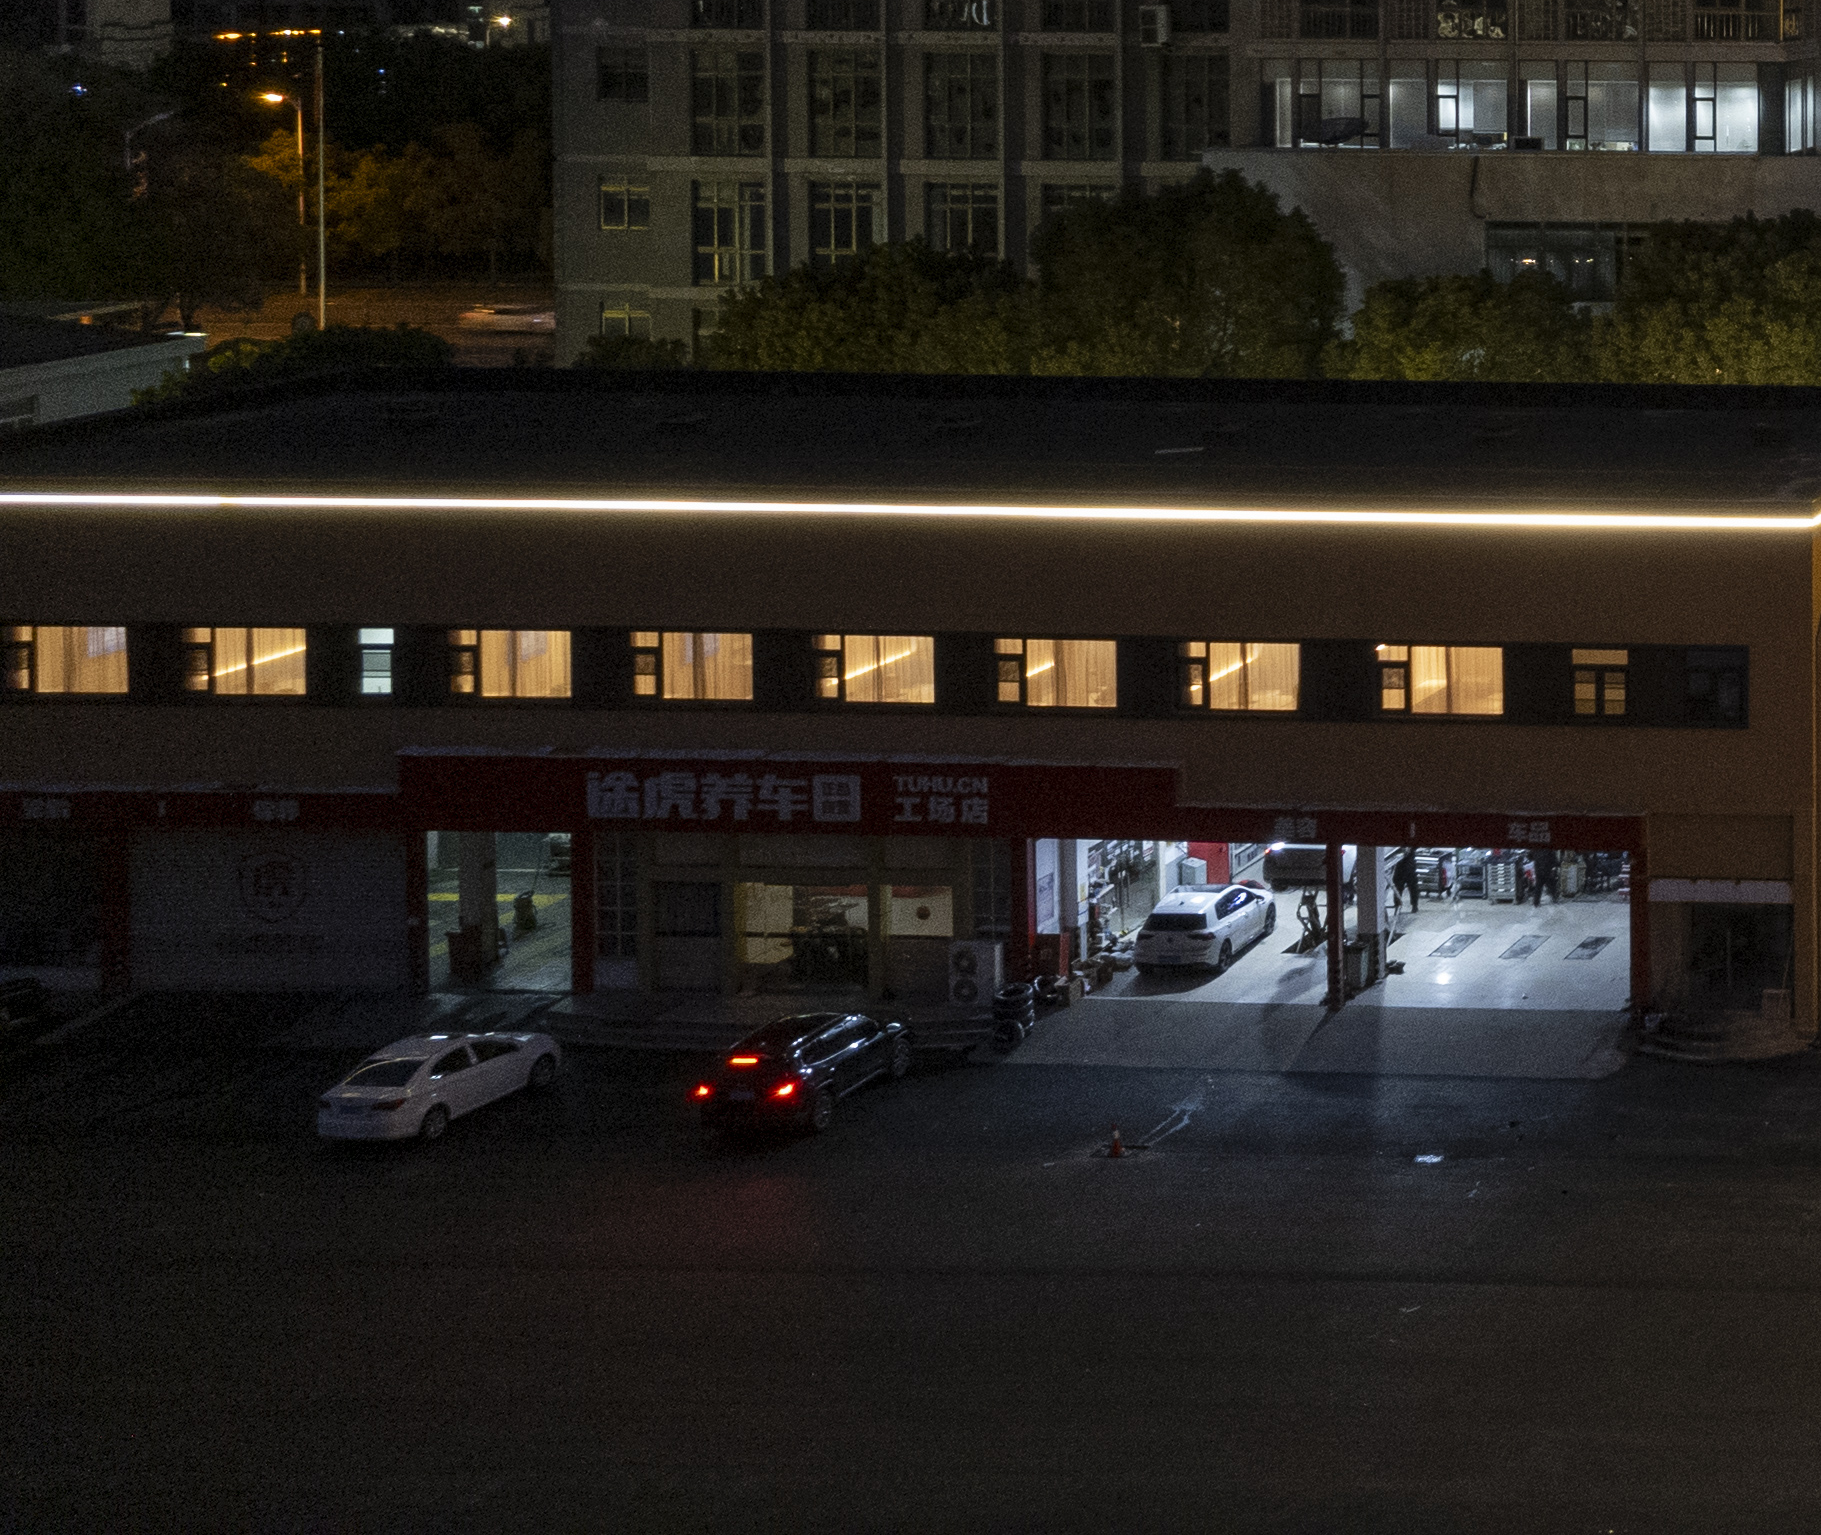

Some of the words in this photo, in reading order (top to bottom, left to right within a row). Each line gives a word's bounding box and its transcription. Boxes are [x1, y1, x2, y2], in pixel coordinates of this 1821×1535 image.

[586, 771, 809, 822] 途虎养车
[893, 775, 989, 795] TUHU.CN
[893, 796, 990, 826] 工场店
